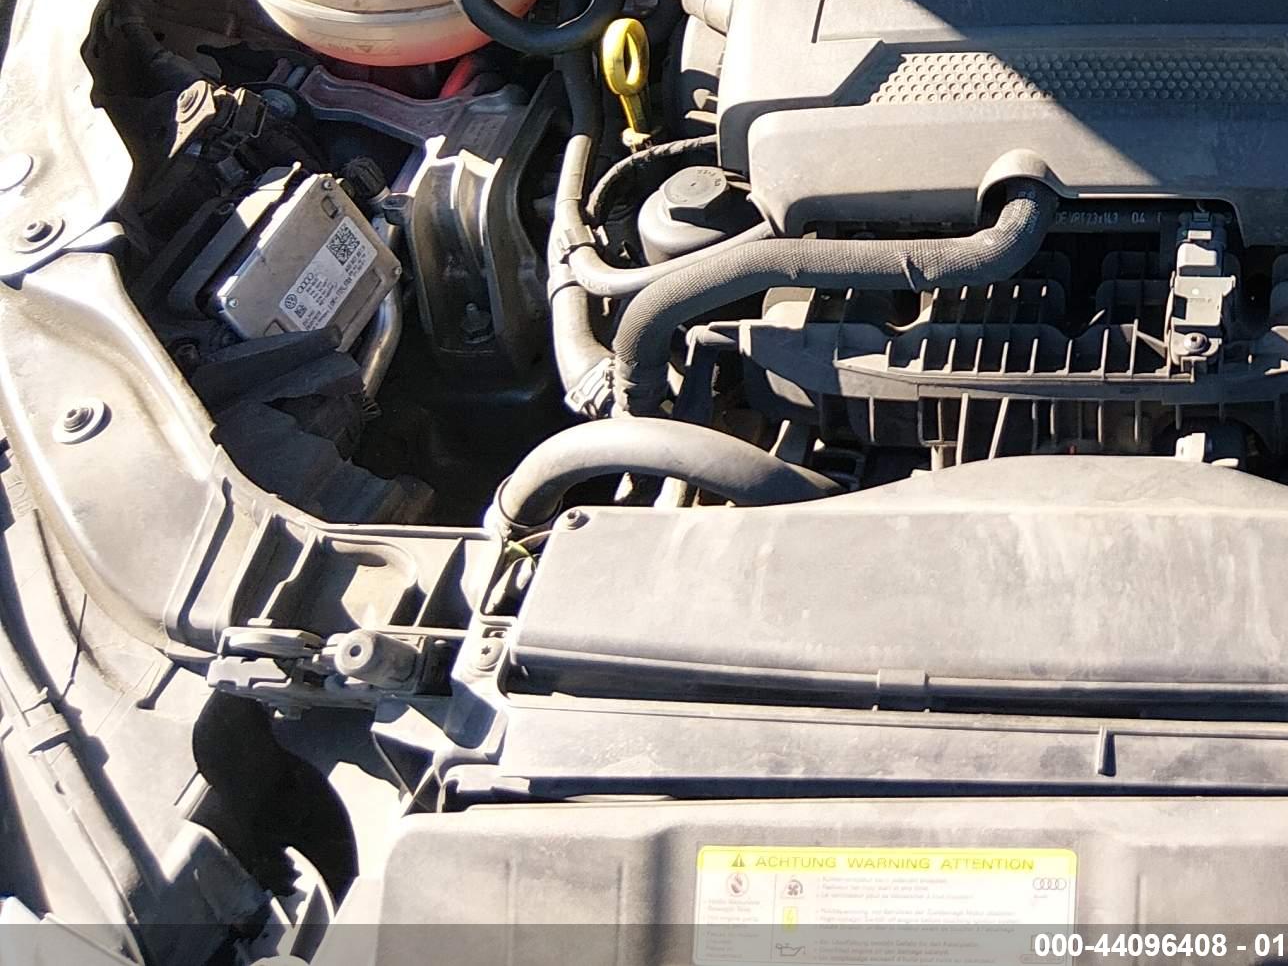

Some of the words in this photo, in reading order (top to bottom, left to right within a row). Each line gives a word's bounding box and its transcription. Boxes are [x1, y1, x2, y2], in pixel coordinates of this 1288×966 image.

[754, 856, 837, 869] ACHTUNG
[847, 857, 932, 870] WARNING
[940, 858, 1035, 870] ATTENTION
